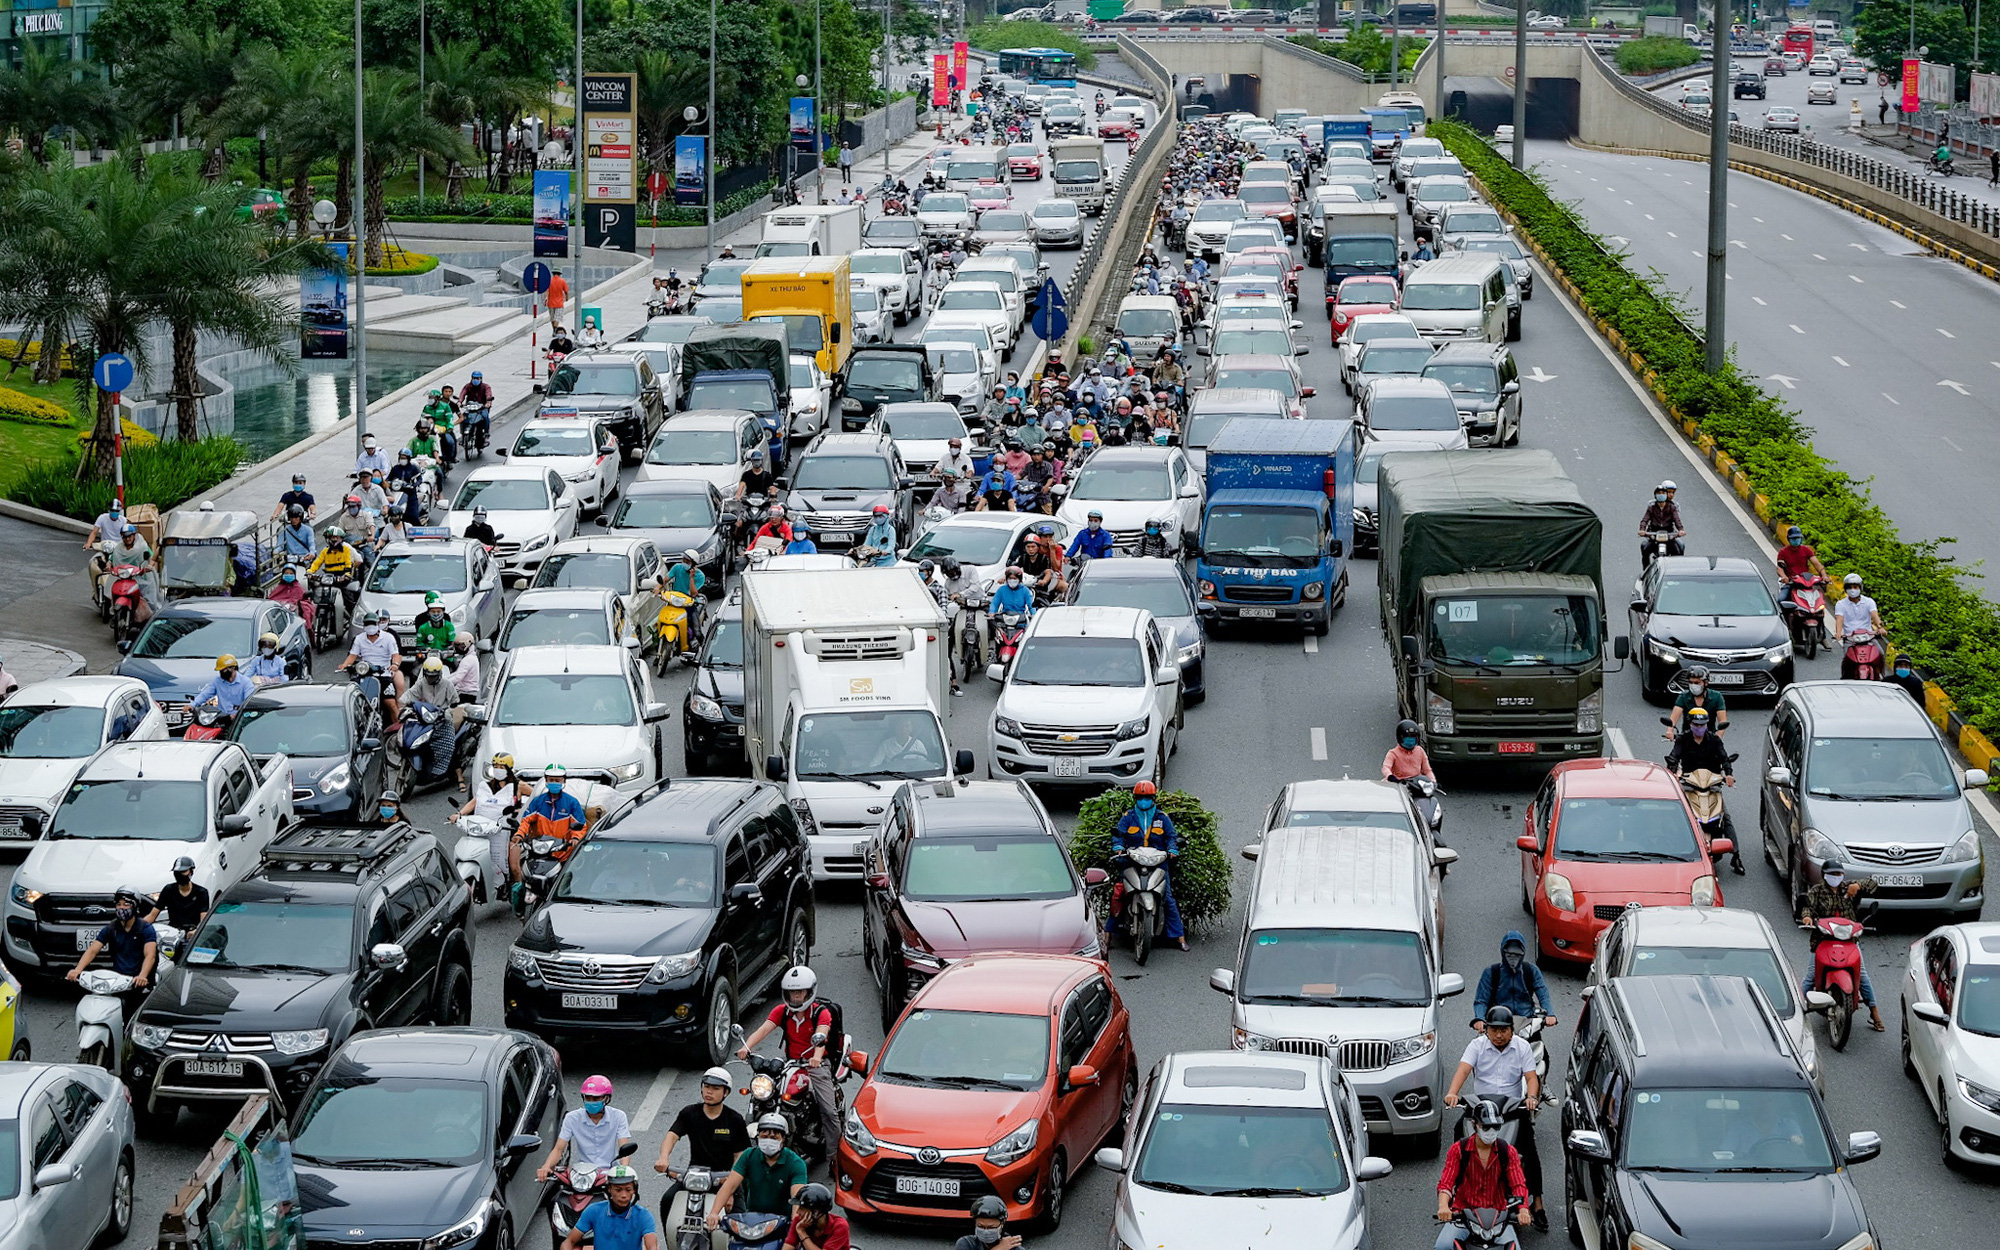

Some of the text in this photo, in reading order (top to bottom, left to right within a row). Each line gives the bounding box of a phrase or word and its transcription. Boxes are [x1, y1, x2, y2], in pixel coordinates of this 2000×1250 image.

[45, 13, 63, 31] LONG
[585, 81, 626, 91] VINCOM
[585, 90, 624, 100] CENTER
[596, 120, 624, 128] VinMart
[600, 208, 620, 234] P
[1263, 465, 1293, 473] VINAFCO
[1222, 567, 1240, 575] XE
[1454, 606, 1471, 619] 07
[1497, 697, 1534, 706] ISUZU
[564, 995, 617, 1008] 30A-033.11
[898, 1179, 959, 1195] 30G-140.99
[348, 1228, 364, 1236] KIA
